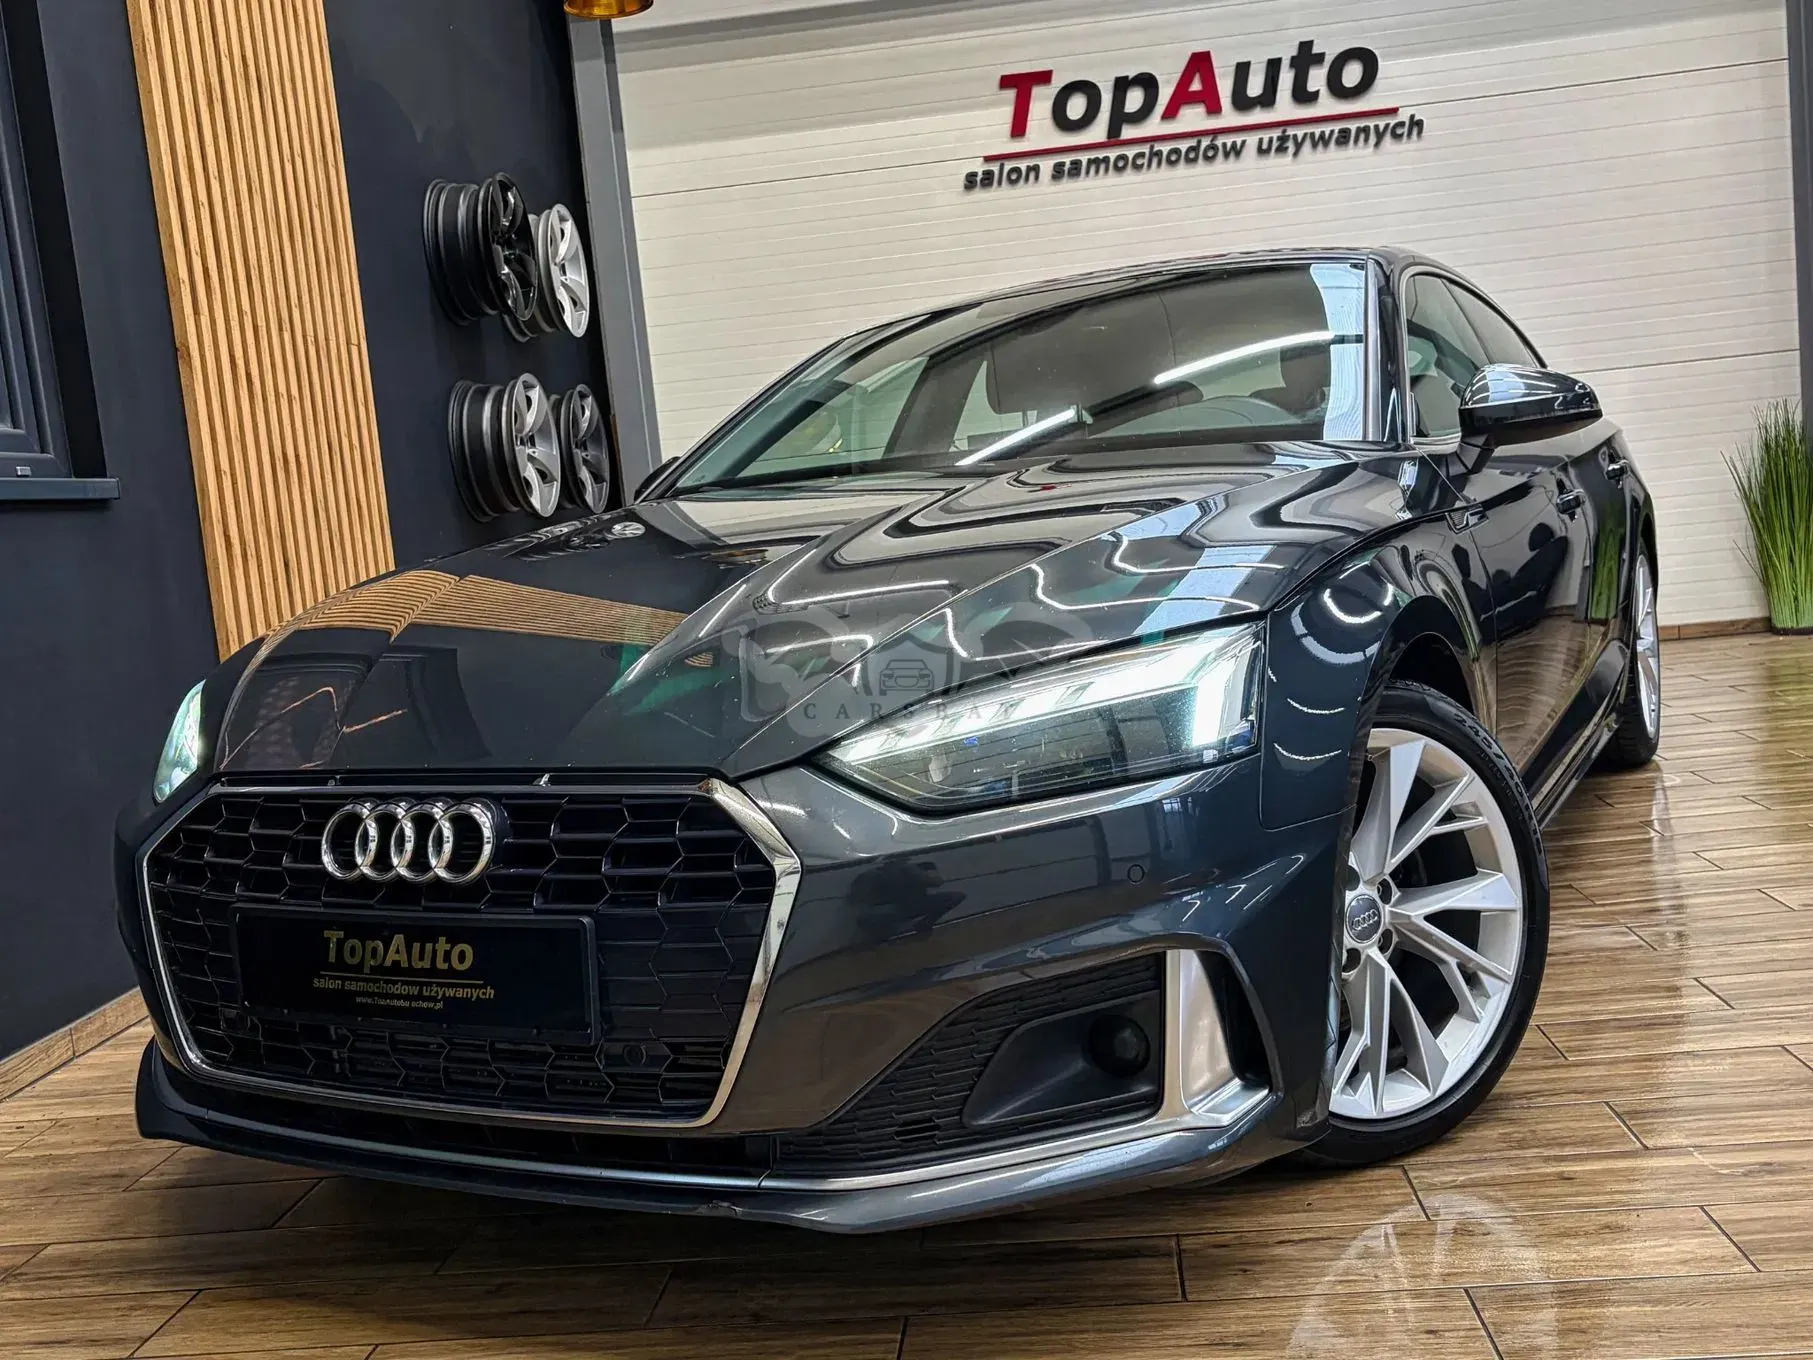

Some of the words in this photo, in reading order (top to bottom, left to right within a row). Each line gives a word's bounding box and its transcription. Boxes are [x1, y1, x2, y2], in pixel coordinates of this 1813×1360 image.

[998, 39, 1380, 140] TopAuto
[963, 161, 1041, 191] salon
[1051, 135, 1246, 181] samochodów
[1257, 114, 1425, 160] używanych
[324, 930, 474, 974] TopAuto
[313, 977, 342, 990] salon
[422, 983, 495, 1001] używanych
